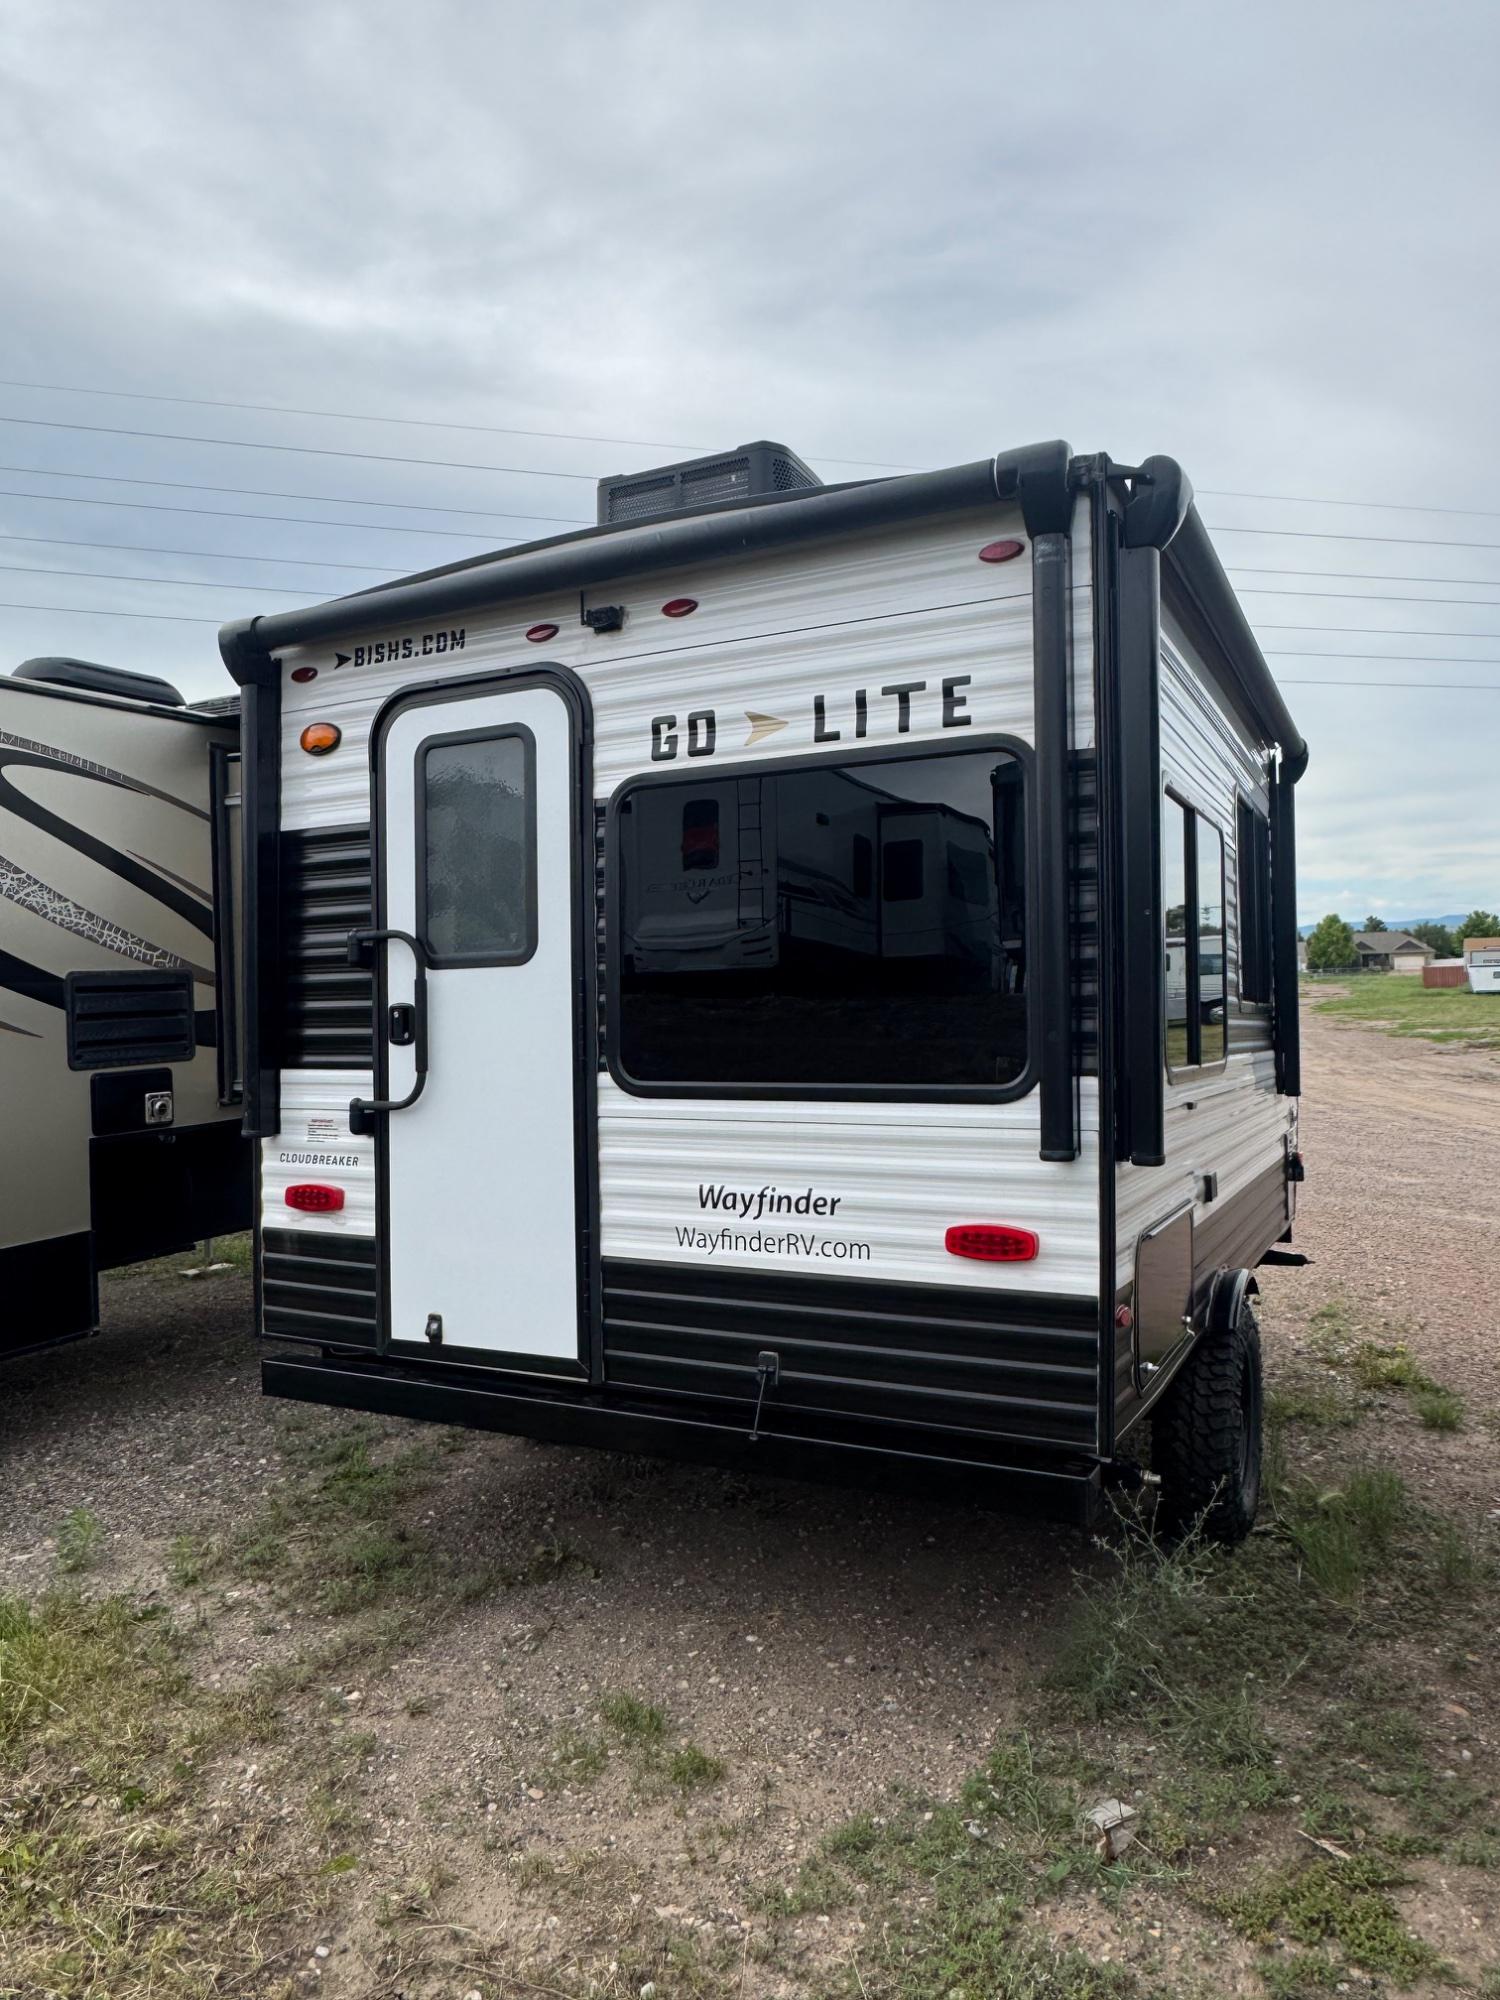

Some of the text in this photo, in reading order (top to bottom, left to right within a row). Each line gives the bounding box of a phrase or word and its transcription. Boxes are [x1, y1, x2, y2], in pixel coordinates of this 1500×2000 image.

[354, 629, 465, 667] BISHS.COM
[651, 675, 972, 762] GO LITE
[279, 1152, 359, 1167] CLOUDBREAKER
[698, 1183, 841, 1220] Wayfinder
[675, 1226, 871, 1260] WayfinderRV.com
